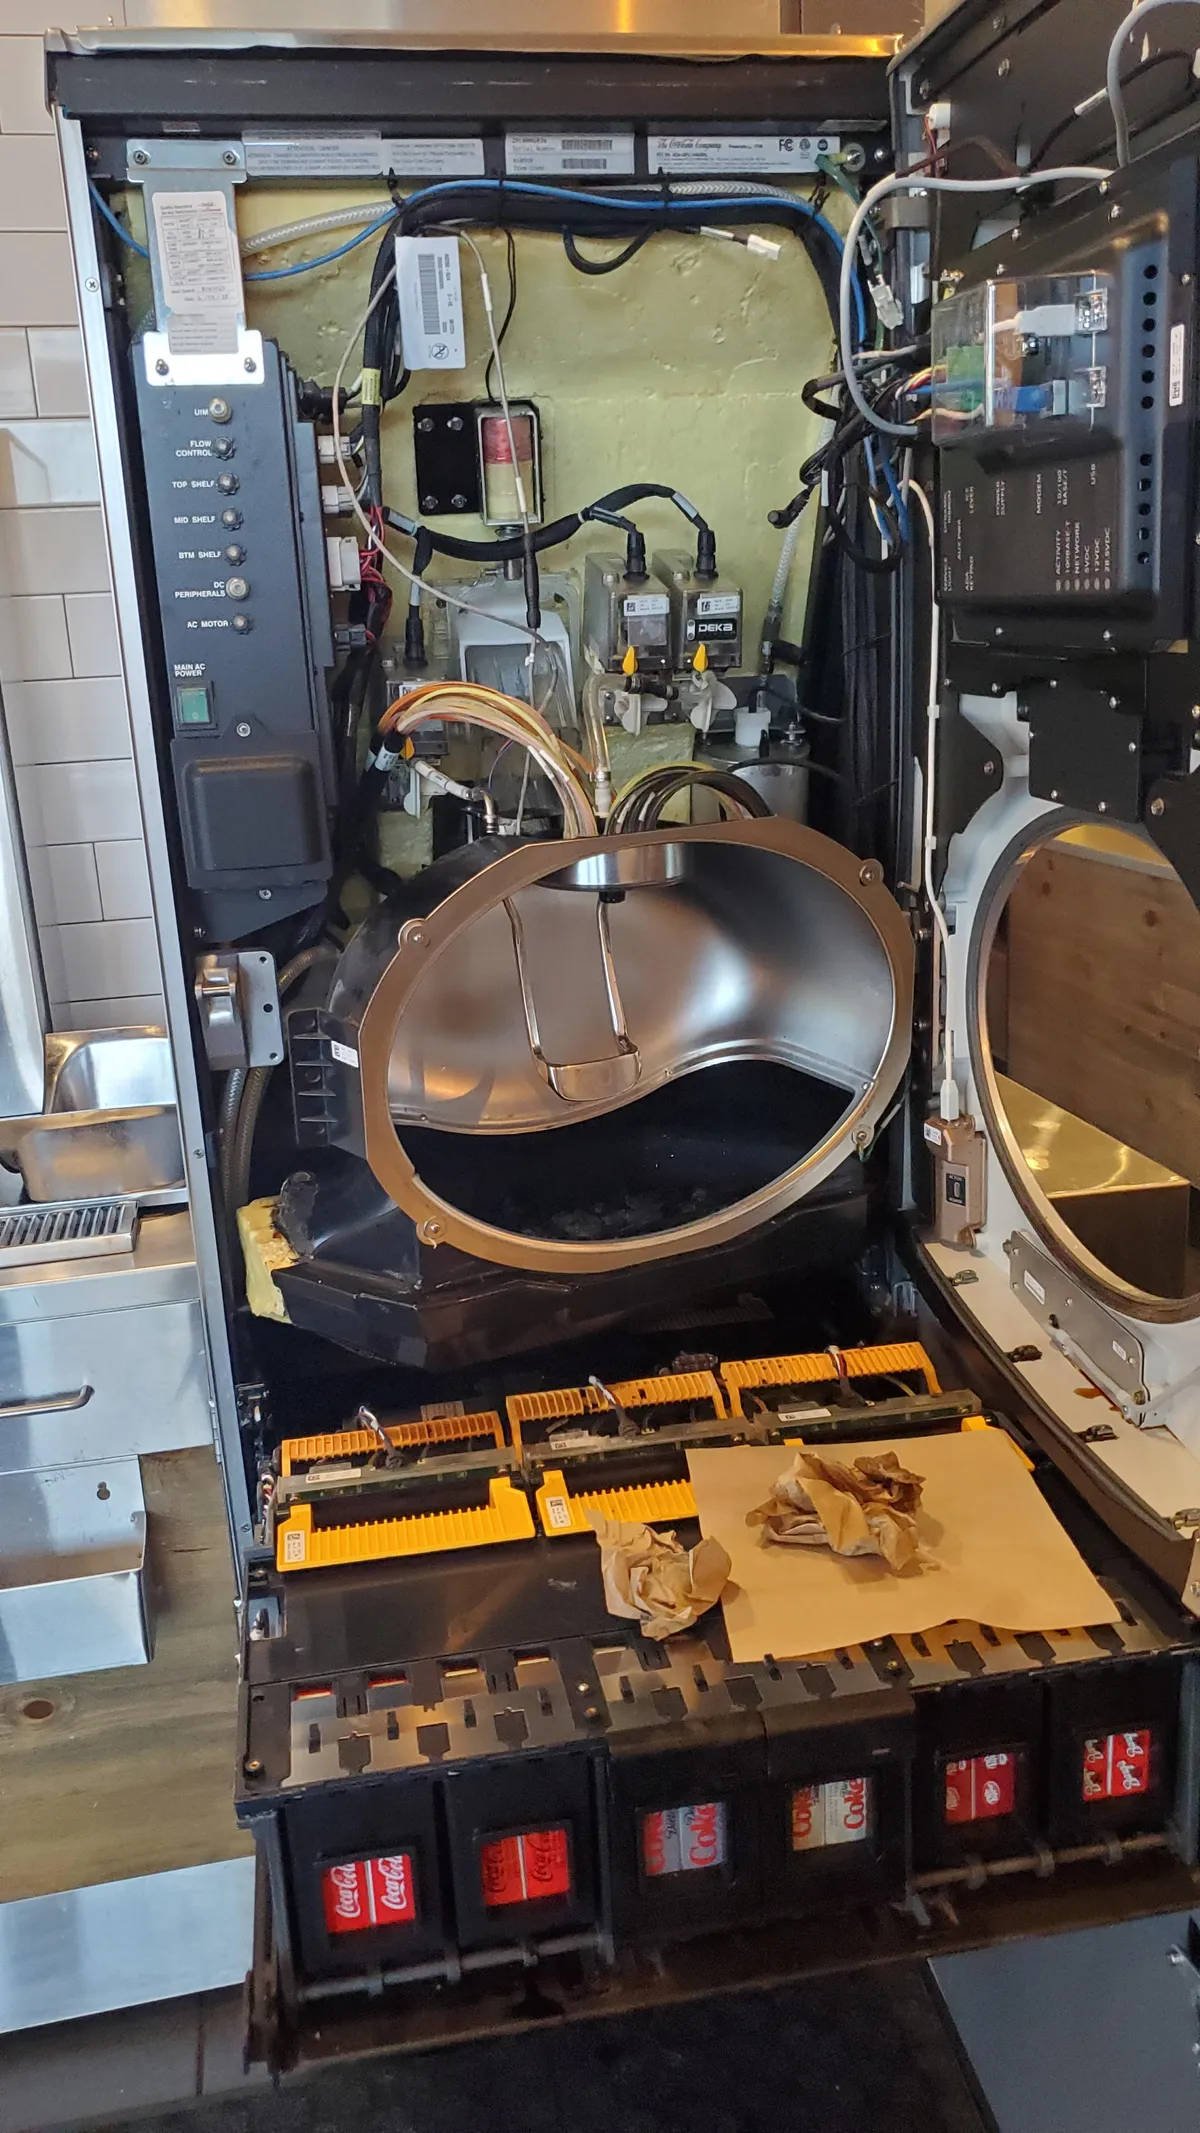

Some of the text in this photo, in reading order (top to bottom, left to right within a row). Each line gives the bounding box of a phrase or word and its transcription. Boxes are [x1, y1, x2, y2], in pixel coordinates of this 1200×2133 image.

[194, 408, 208, 416] UIM
[190, 440, 212, 448] FLOW
[176, 449, 212, 457] CONTROL
[172, 480, 214, 489] TOP SHELF
[174, 516, 190, 524] MID
[198, 551, 222, 559] SHELF
[214, 581, 225, 589] DC
[175, 590, 226, 599] PERIPHERALS
[201, 620, 229, 628] MOTOR
[698, 624, 733, 632] DEKA
[844, 1778, 865, 1830] Coke
